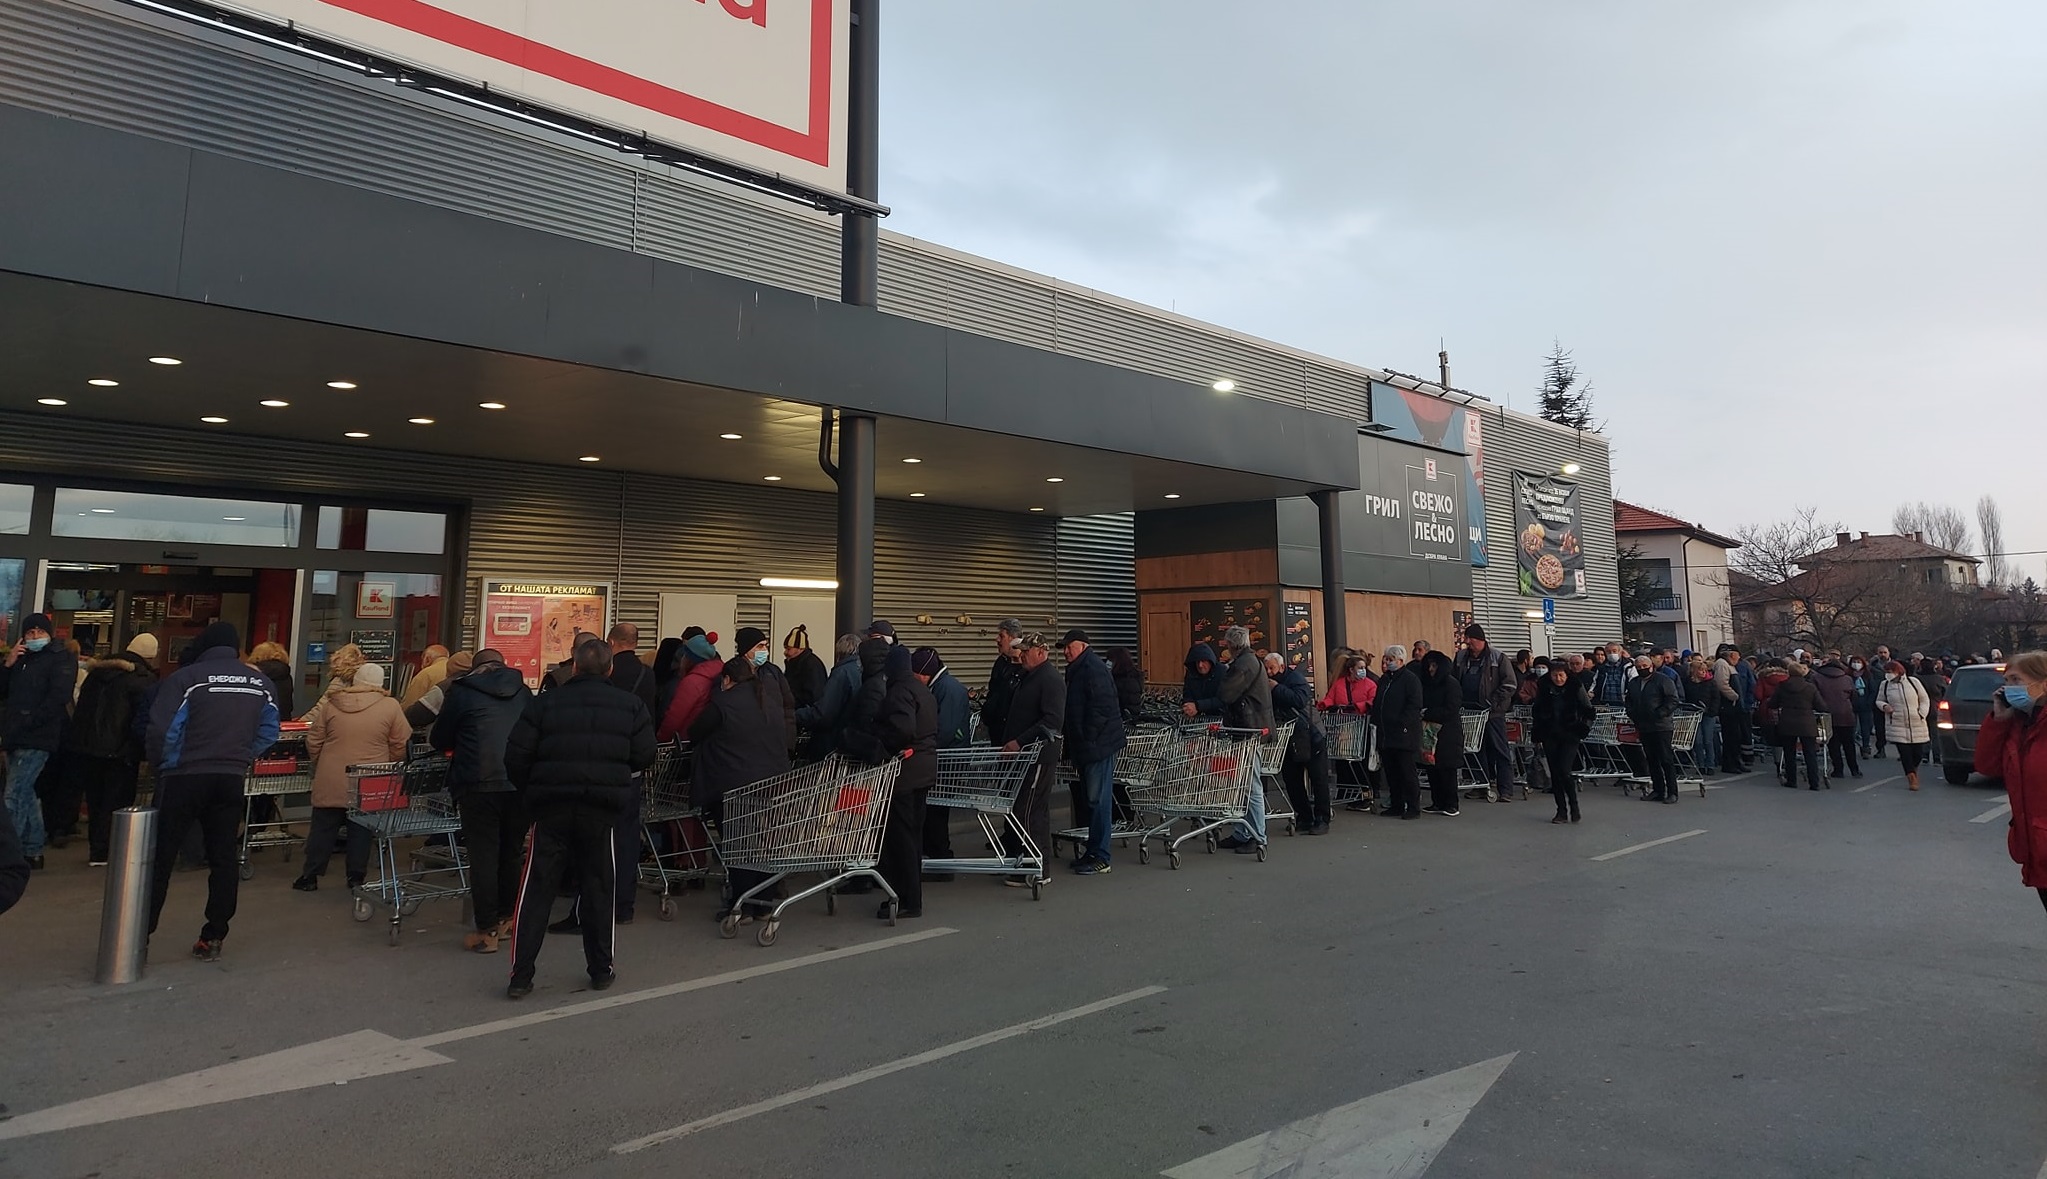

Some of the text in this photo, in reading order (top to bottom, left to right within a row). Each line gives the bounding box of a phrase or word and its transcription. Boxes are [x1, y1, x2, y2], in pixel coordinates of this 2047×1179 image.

[1365, 494, 1400, 519] ГРИЛ
[1412, 490, 1454, 514] СВЕЖО
[1431, 512, 1438, 523] &
[1414, 521, 1455, 544] ЛЕСНО
[500, 585, 512, 593] ОТ
[514, 586, 551, 594] НАШАТА
